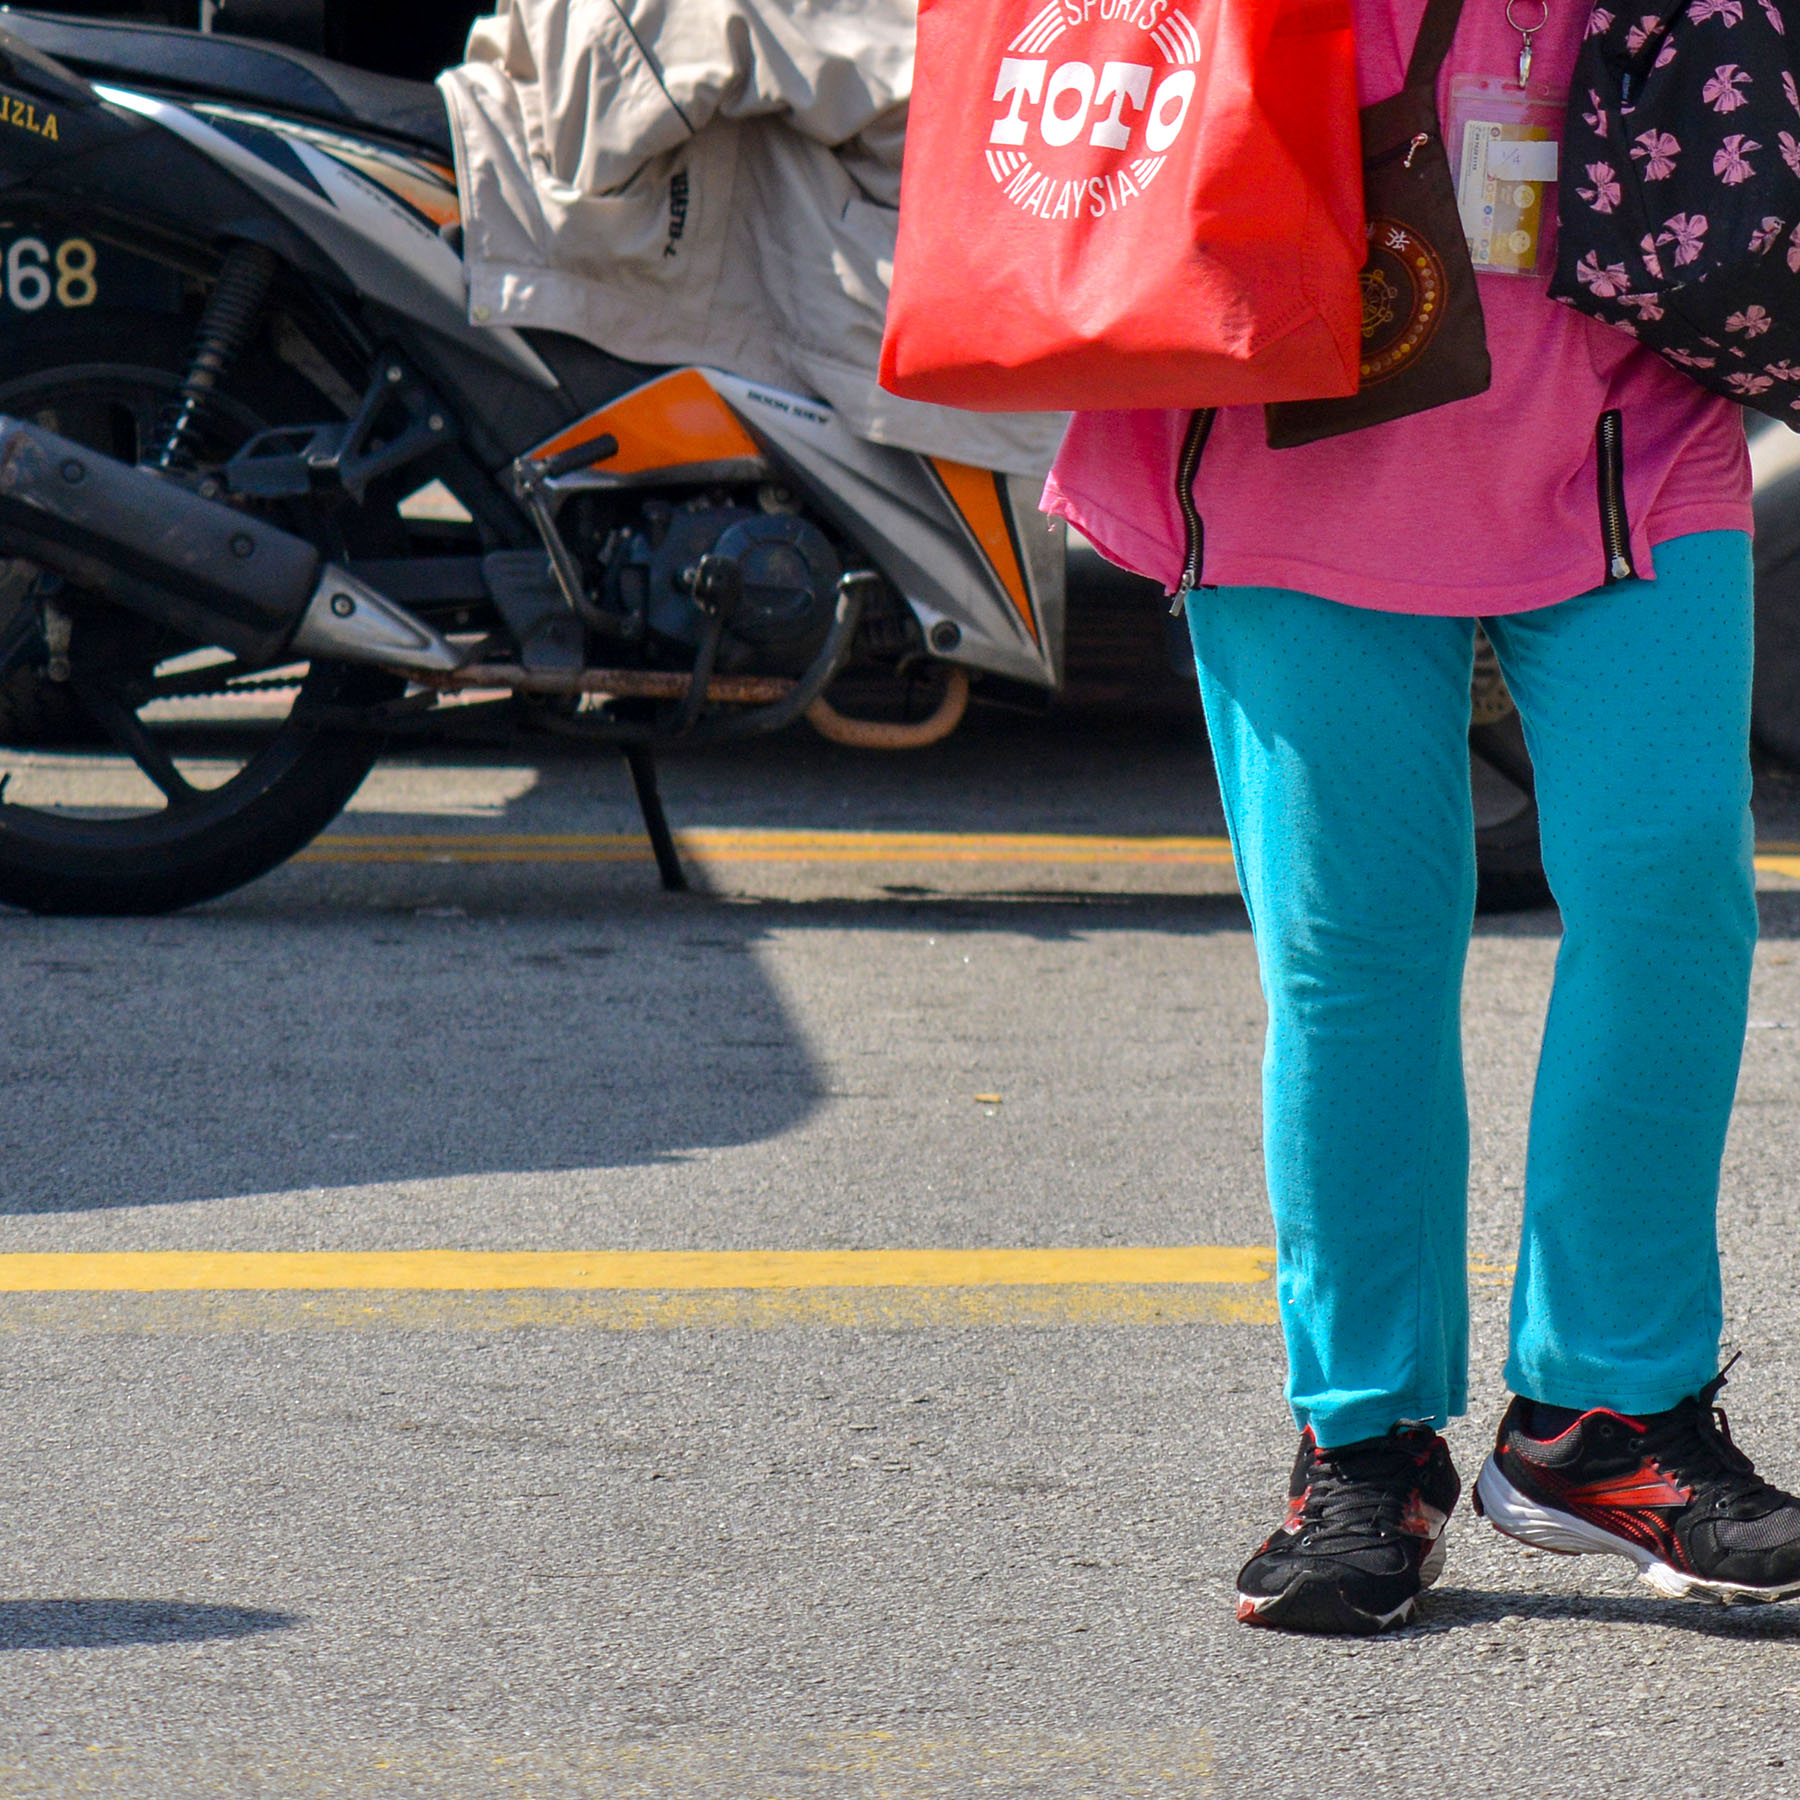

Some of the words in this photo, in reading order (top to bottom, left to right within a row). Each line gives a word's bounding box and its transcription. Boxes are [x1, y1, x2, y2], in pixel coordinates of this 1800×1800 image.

[989, 57, 1197, 152] TOTO
[1003, 161, 1140, 220] MALAYSIA
[0, 237, 97, 311] 68
